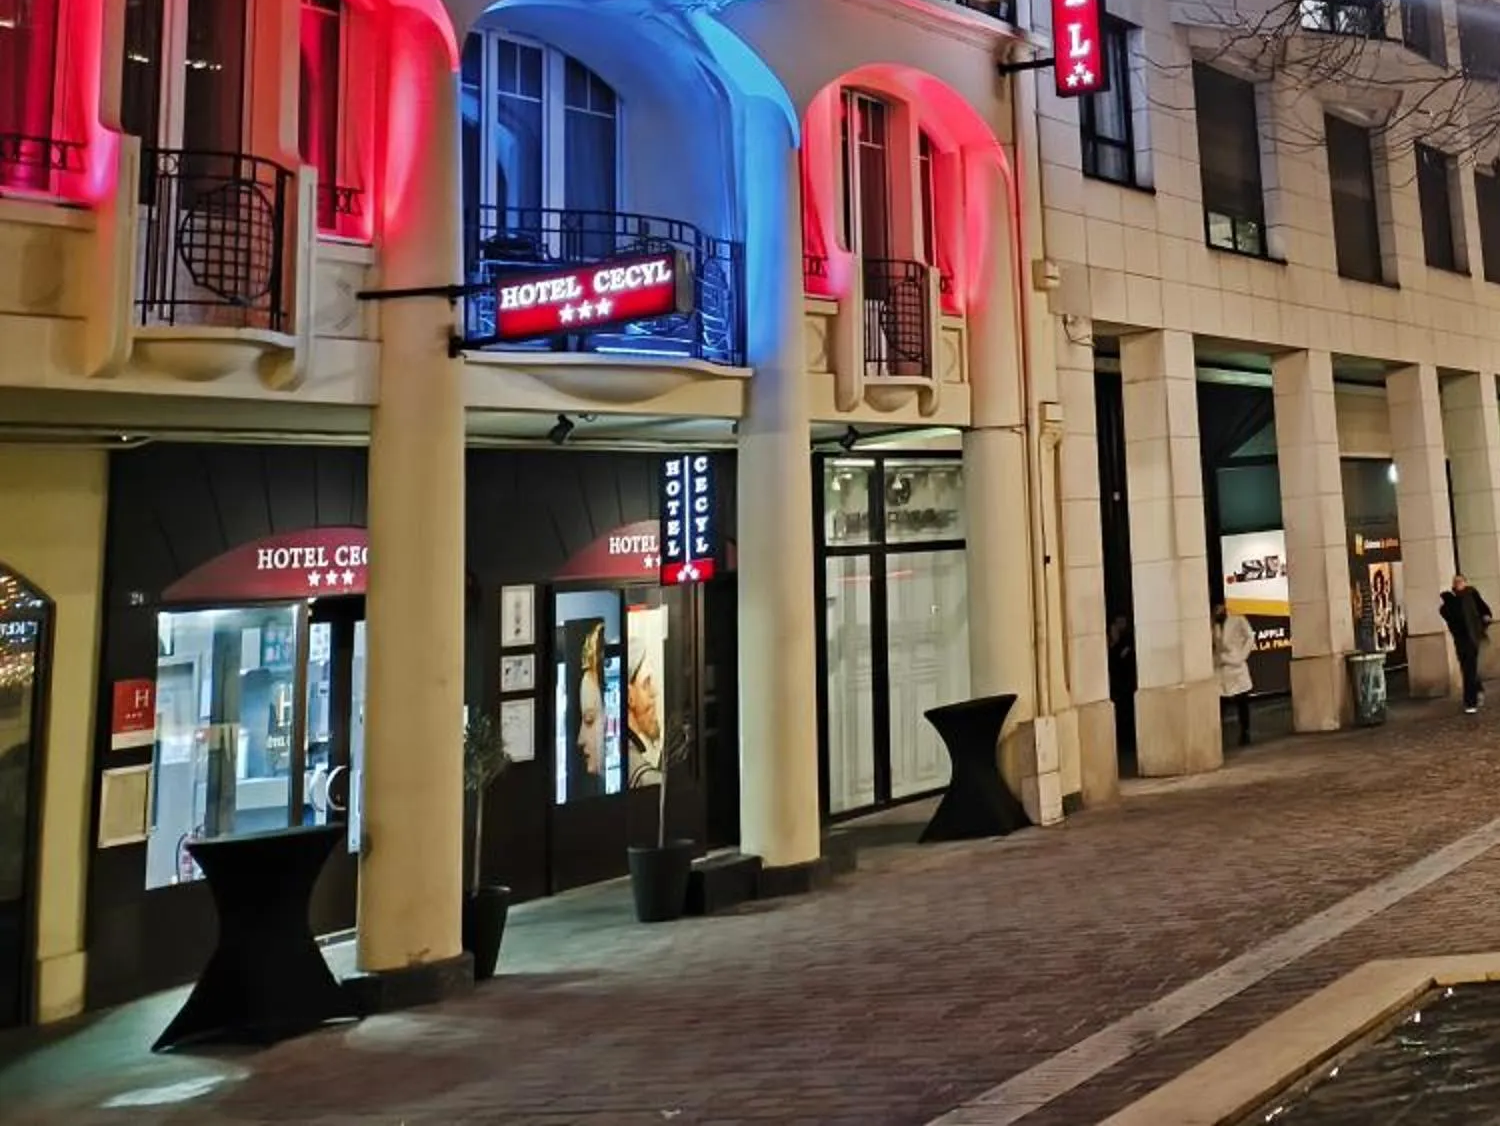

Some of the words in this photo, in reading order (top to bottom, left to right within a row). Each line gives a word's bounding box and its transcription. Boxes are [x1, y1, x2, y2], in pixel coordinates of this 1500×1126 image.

[500, 276, 581, 309] HOTEL
[593, 259, 672, 292] CECYL
[665, 460, 681, 557] HOTEL
[694, 457, 709, 553] CECYL
[257, 546, 329, 570] HOTEL
[608, 535, 660, 555] HOTEL
[134, 688, 149, 709] H
